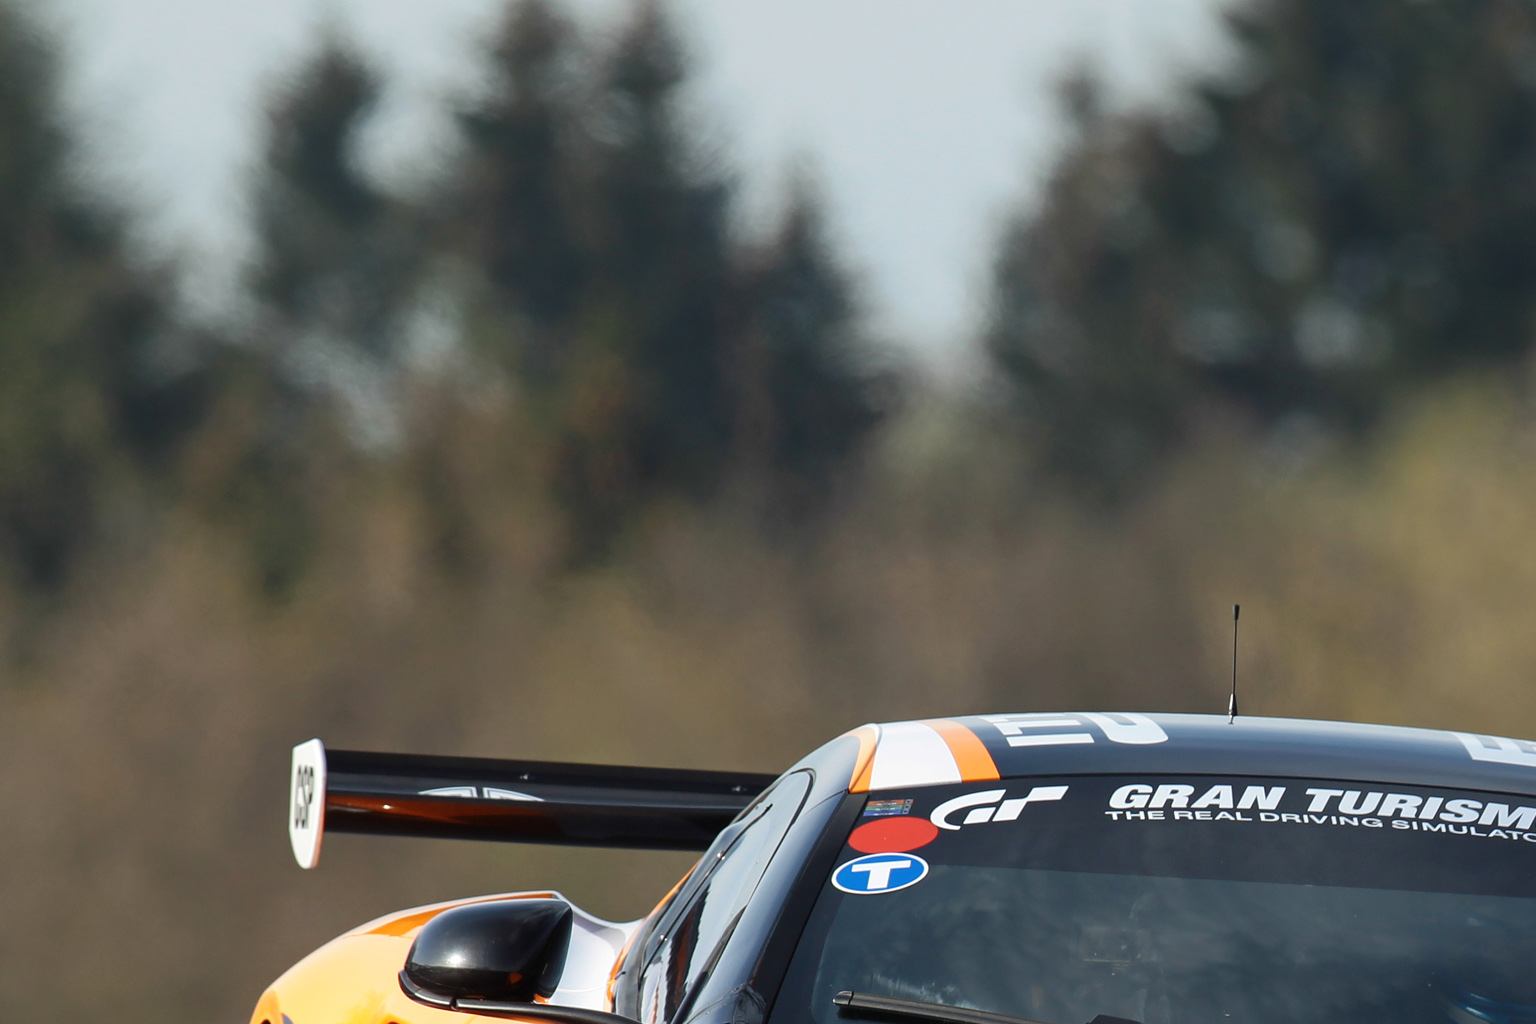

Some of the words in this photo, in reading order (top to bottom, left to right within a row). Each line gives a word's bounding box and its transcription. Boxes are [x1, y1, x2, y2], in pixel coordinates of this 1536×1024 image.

[1108, 784, 1287, 810] GRAN
[1105, 811, 1166, 821] THE
[1174, 811, 1253, 823] REAL
[1259, 813, 1384, 828] DRIVING
[851, 860, 912, 890] T
